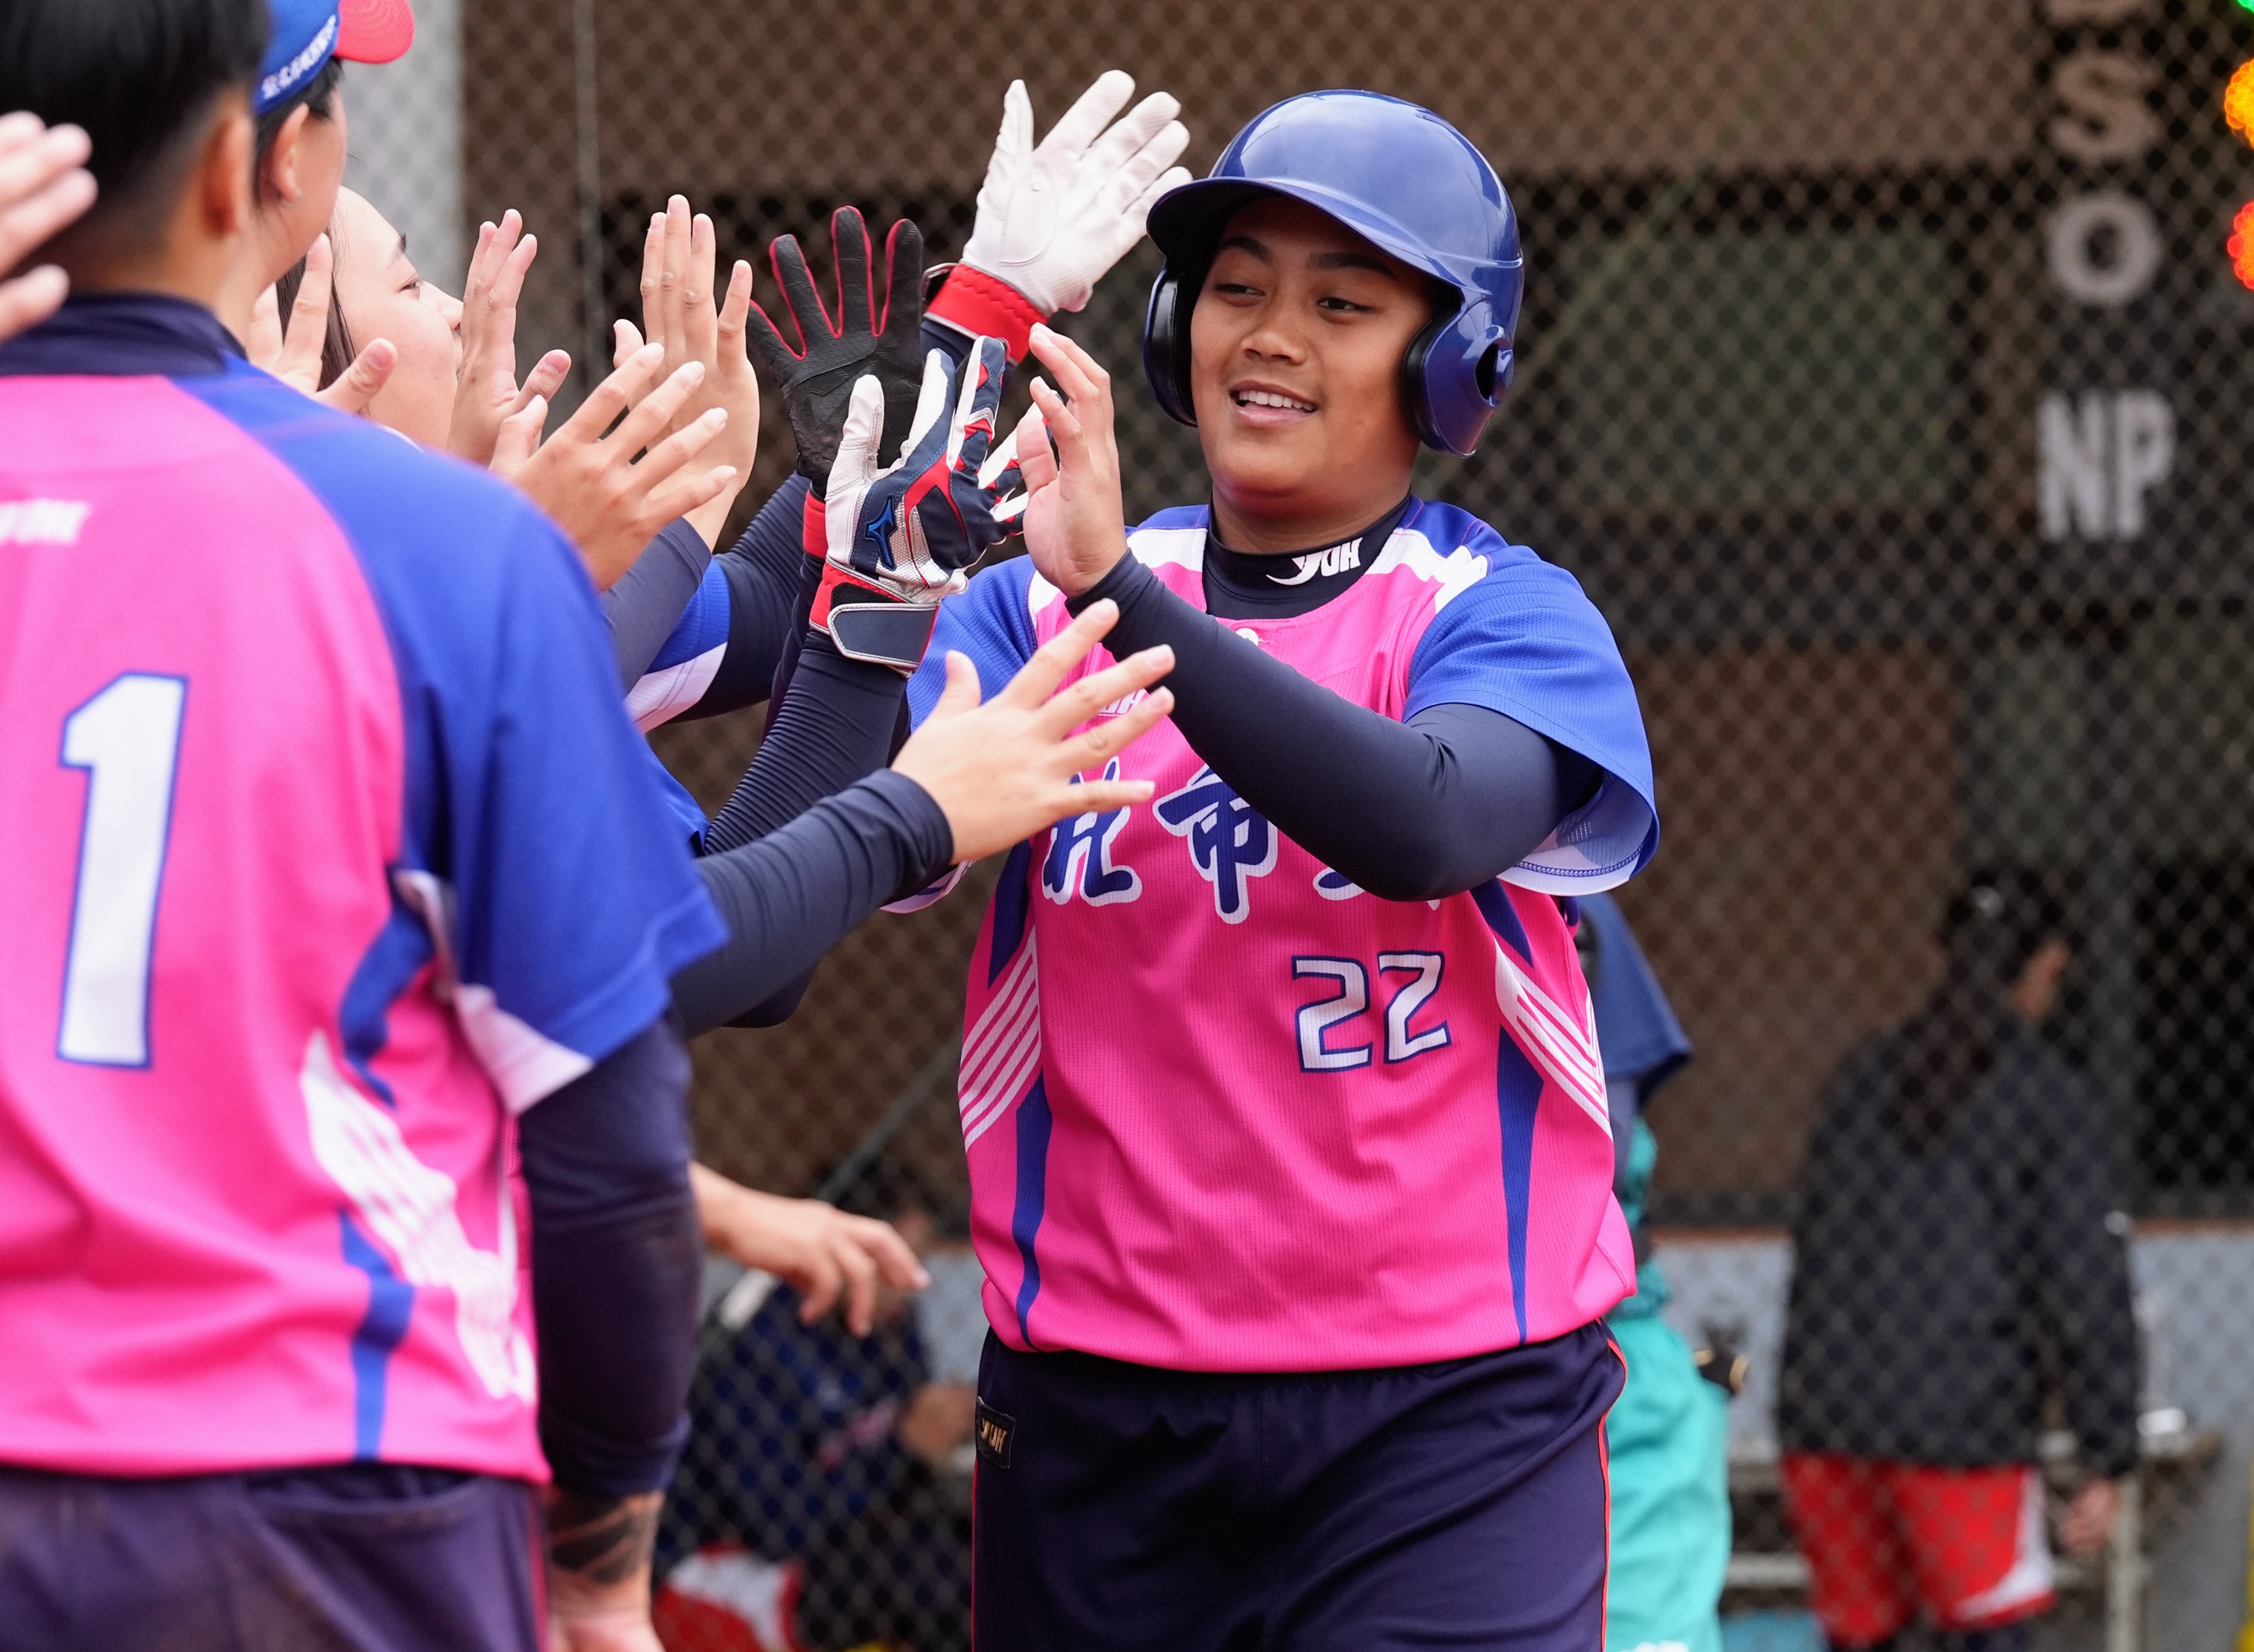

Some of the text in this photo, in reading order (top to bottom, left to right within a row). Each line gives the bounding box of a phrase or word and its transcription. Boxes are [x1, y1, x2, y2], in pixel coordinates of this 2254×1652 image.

[2039, 388, 2175, 540] NP
[57, 671, 188, 1068] 1
[1292, 950, 1452, 1073] 22
